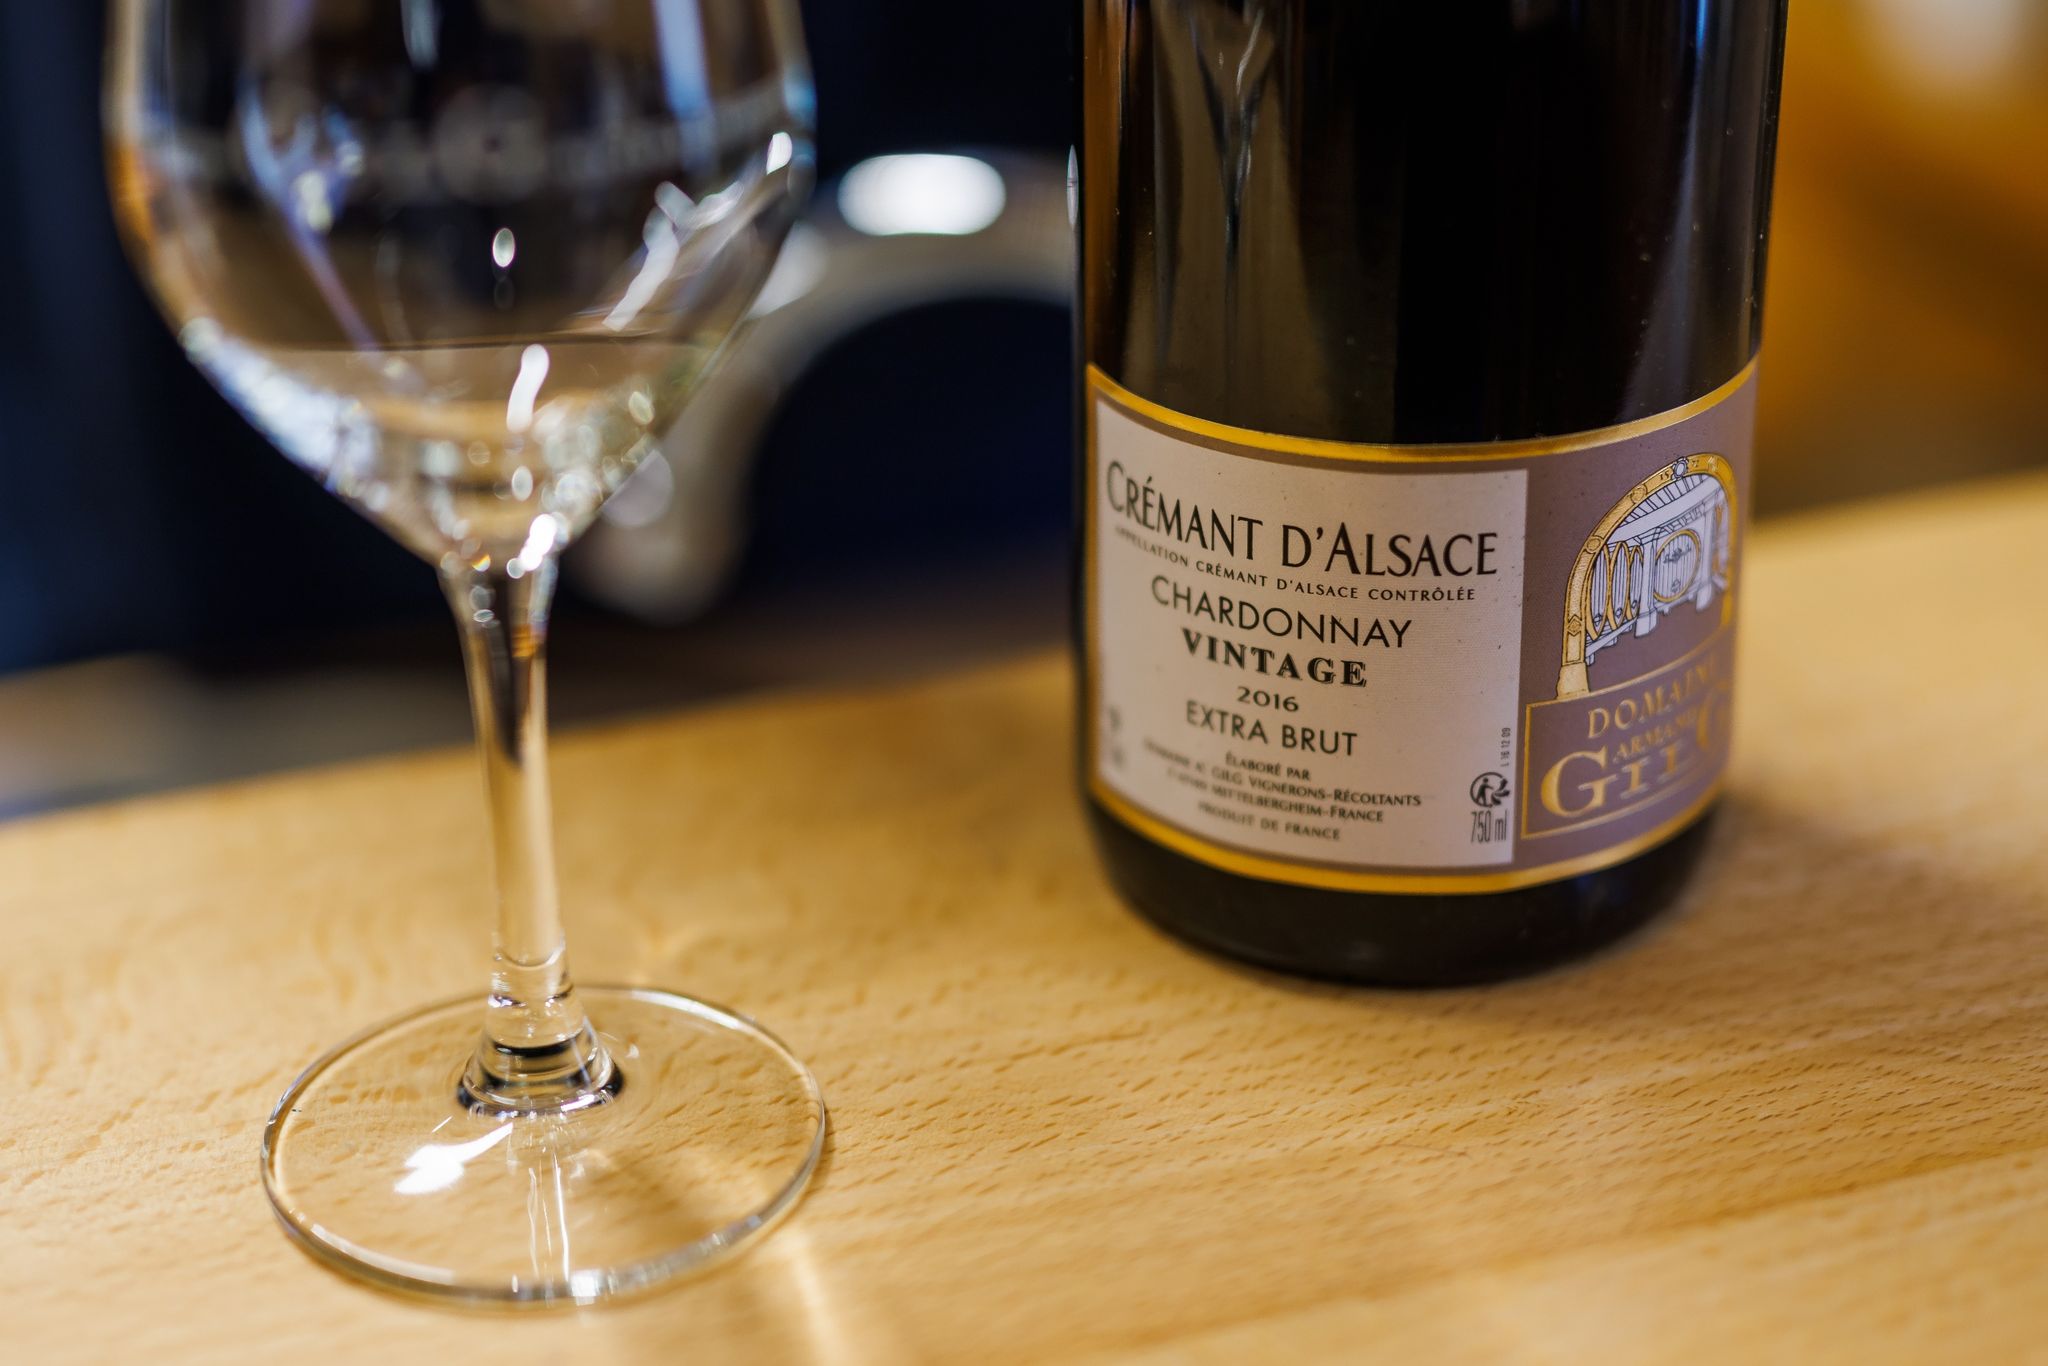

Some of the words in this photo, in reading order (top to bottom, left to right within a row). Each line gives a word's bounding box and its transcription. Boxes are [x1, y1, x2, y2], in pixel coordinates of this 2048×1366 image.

[1107, 460, 1263, 560] CRÉMANT
[1281, 522, 1497, 577] D'ALSACE
[1196, 560, 1268, 588] CRÉMANT
[1277, 578, 1358, 600] D'ALSACE
[1368, 586, 1476, 602] CONTRÔLÉE
[1151, 575, 1412, 648] CHARDONNAY
[1182, 627, 1367, 688] VINTAGE
[1237, 685, 1300, 713] 2016
[1186, 698, 1269, 746] EXTRA
[1282, 724, 1358, 757] BRUT
[1225, 750, 1281, 777] ÉLABORÉ
[1287, 766, 1310, 780] PAR
[1199, 800, 1255, 826] PRODUIT
[1260, 817, 1279, 833] DE
[1285, 822, 1341, 841] FRANCE
[1471, 809, 1492, 844] 750
[1495, 809, 1508, 842] ml
